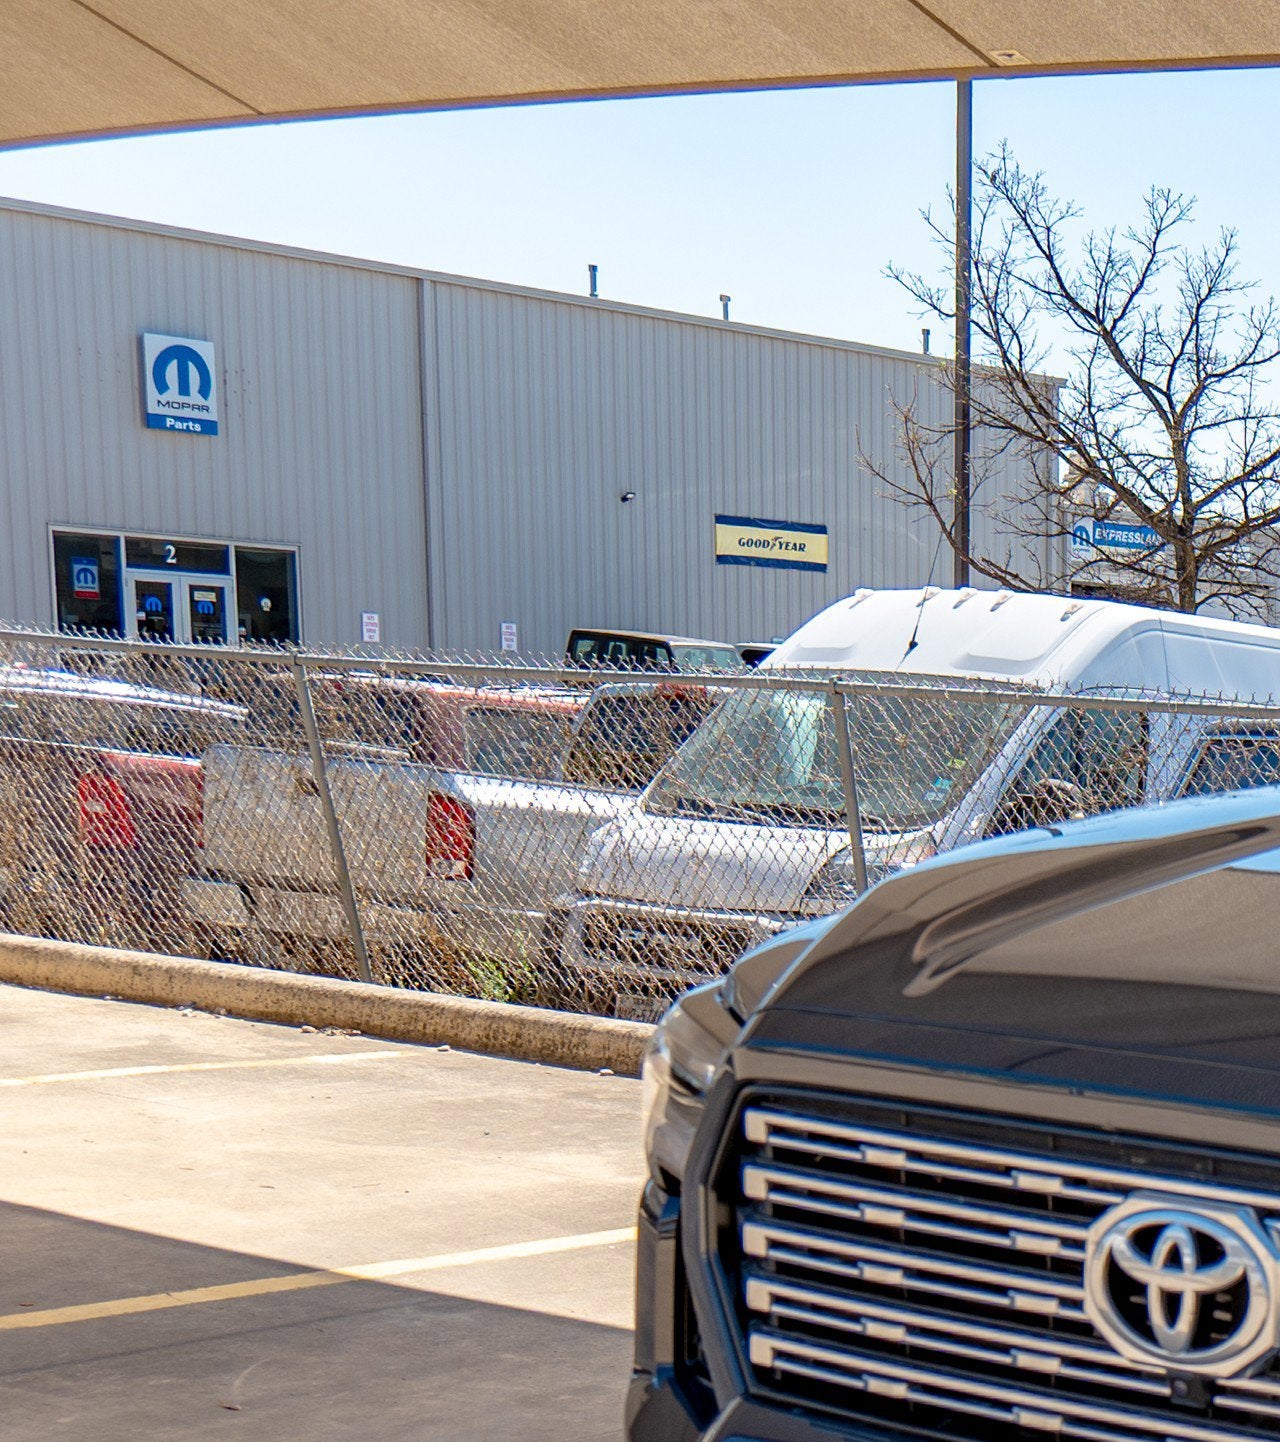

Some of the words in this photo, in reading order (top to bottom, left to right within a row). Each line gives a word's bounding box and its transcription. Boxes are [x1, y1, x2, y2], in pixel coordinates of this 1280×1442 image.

[157, 399, 210, 414] MOPAR
[166, 418, 202, 432] Parts
[165, 544, 177, 564] 2
